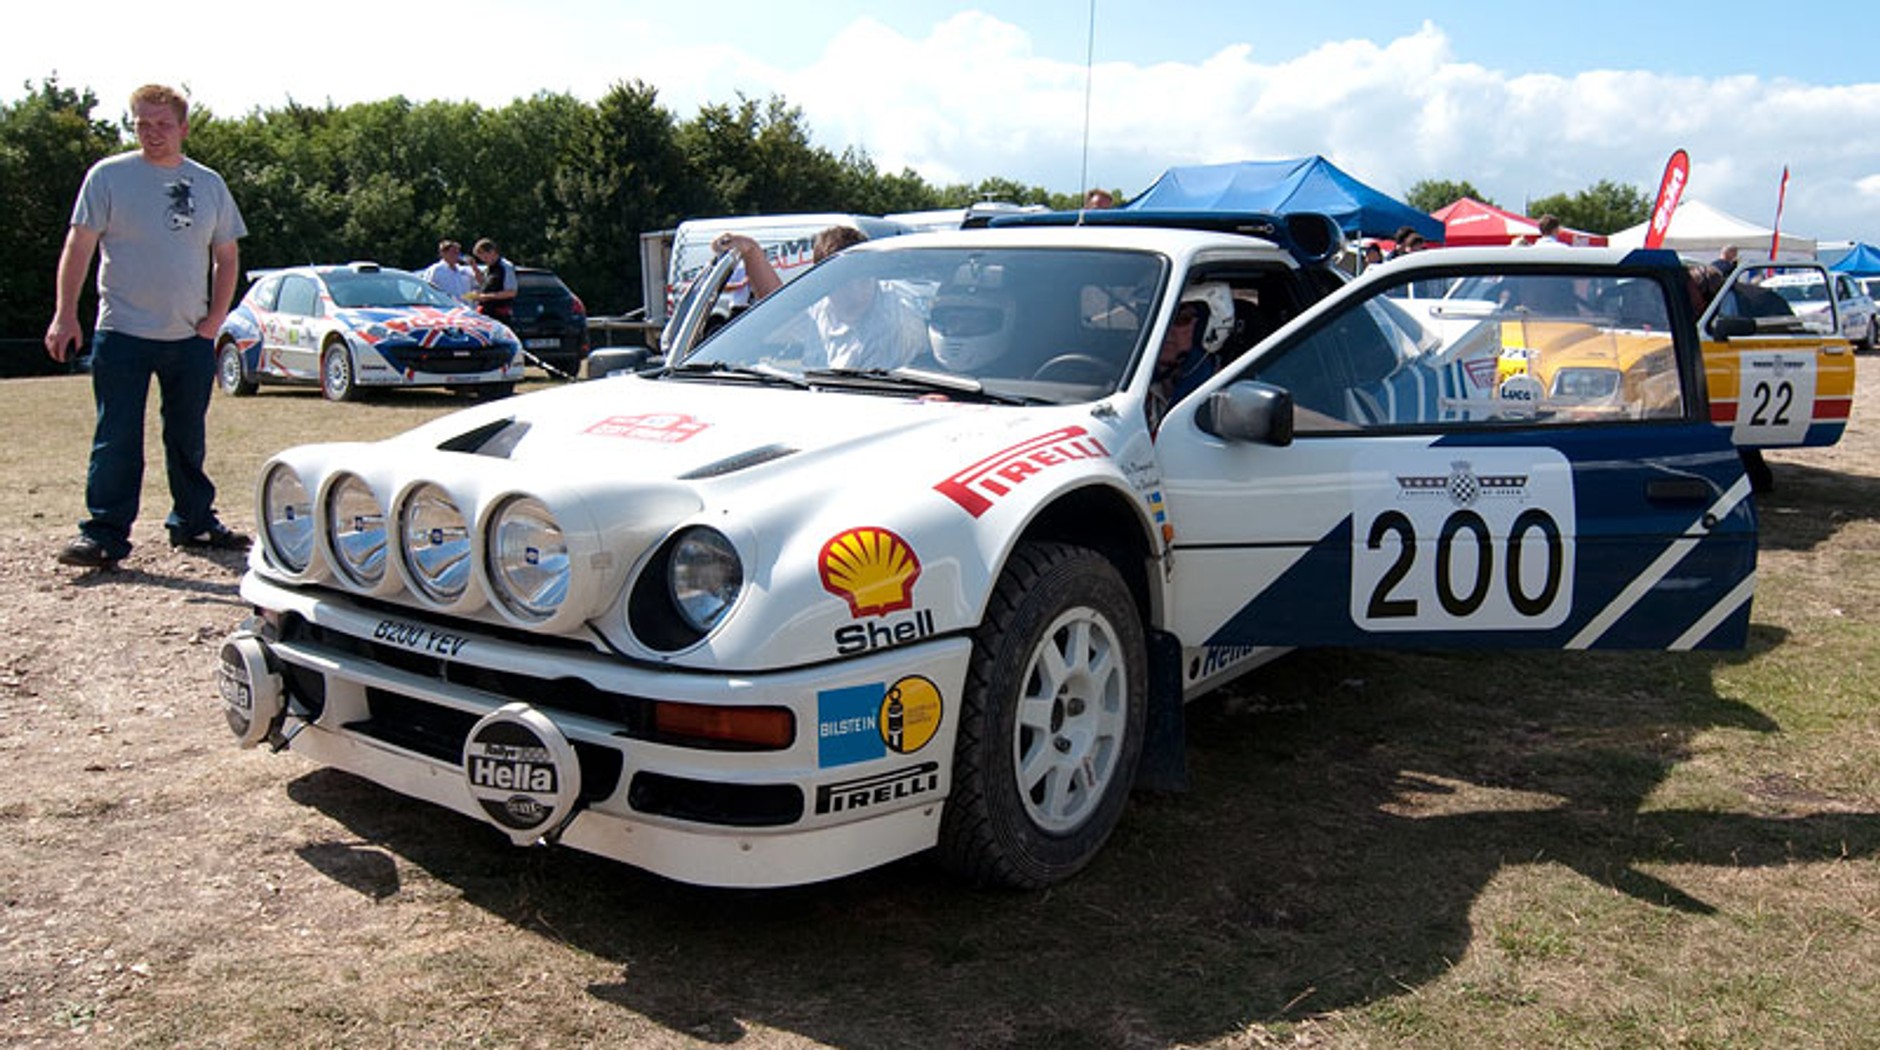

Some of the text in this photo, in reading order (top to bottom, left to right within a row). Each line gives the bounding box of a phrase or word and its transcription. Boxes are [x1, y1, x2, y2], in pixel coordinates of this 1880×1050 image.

[1749, 381, 1793, 426] 22
[932, 425, 1111, 519] PIRELLI
[1366, 508, 1564, 619] 200
[373, 620, 470, 656] B200 YEV
[834, 608, 935, 655] Shell
[819, 715, 876, 738] BILSTEIN
[474, 758, 552, 792] Hella
[815, 761, 939, 816] PIRELLI
